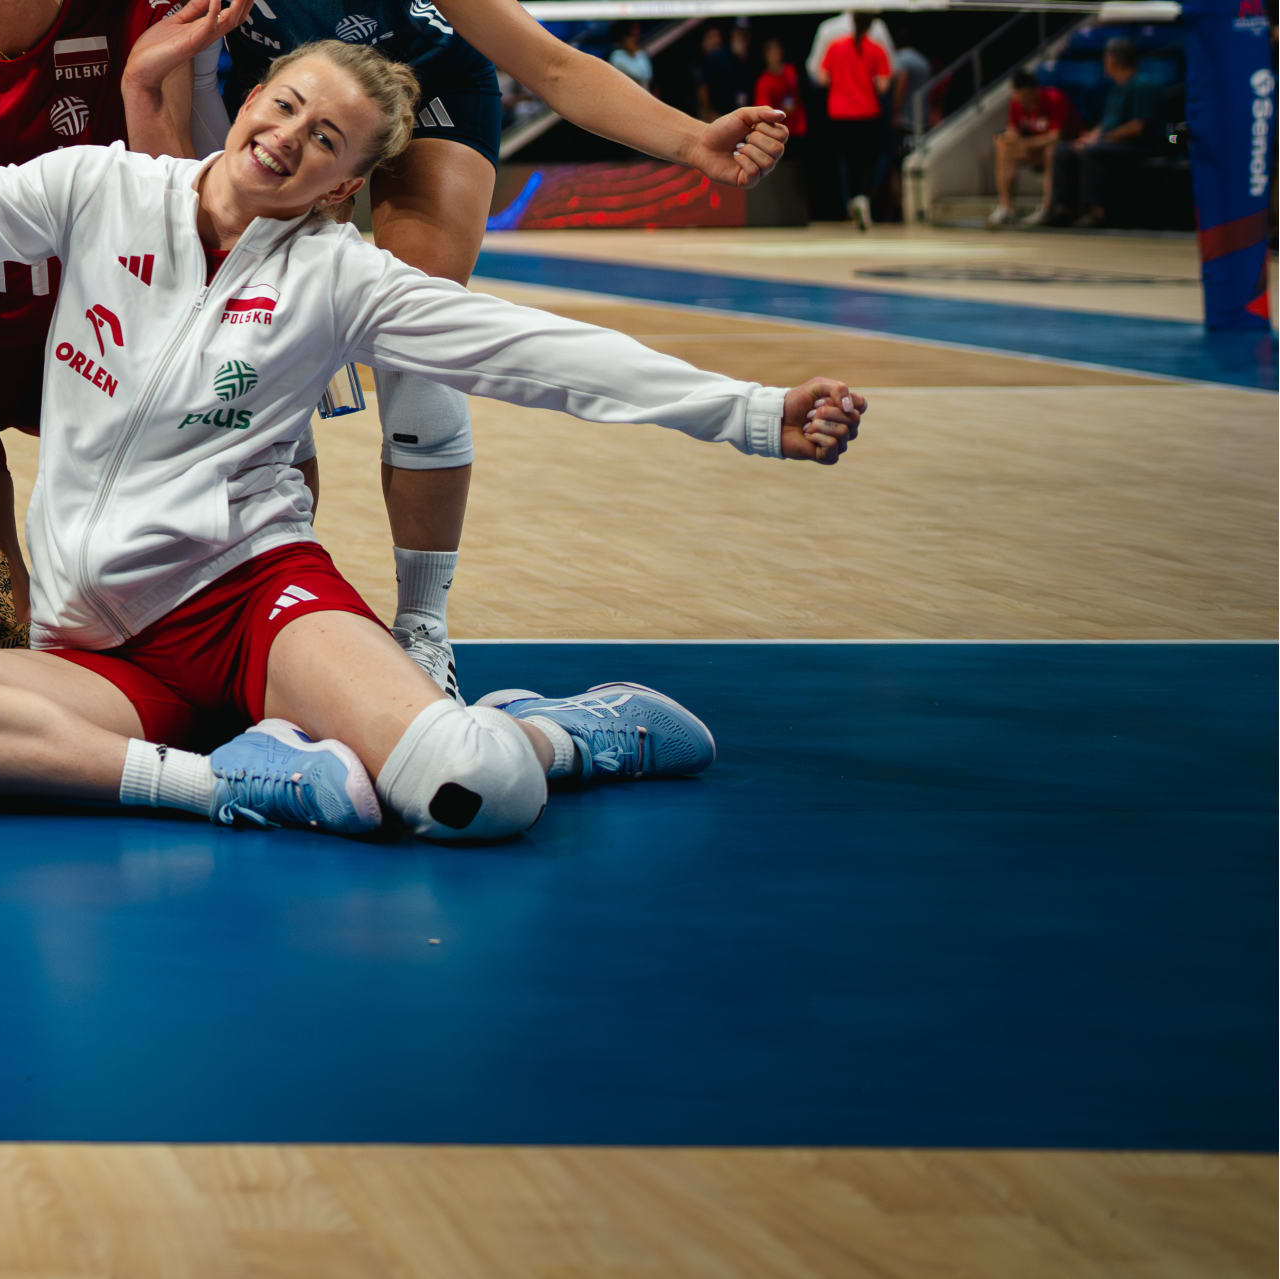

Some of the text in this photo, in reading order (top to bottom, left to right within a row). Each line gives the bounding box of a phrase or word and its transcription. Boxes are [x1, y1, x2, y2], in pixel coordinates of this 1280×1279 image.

[240, 25, 282, 51] LEN
[220, 311, 272, 325] POLSKA
[55, 341, 119, 397] ORLEN
